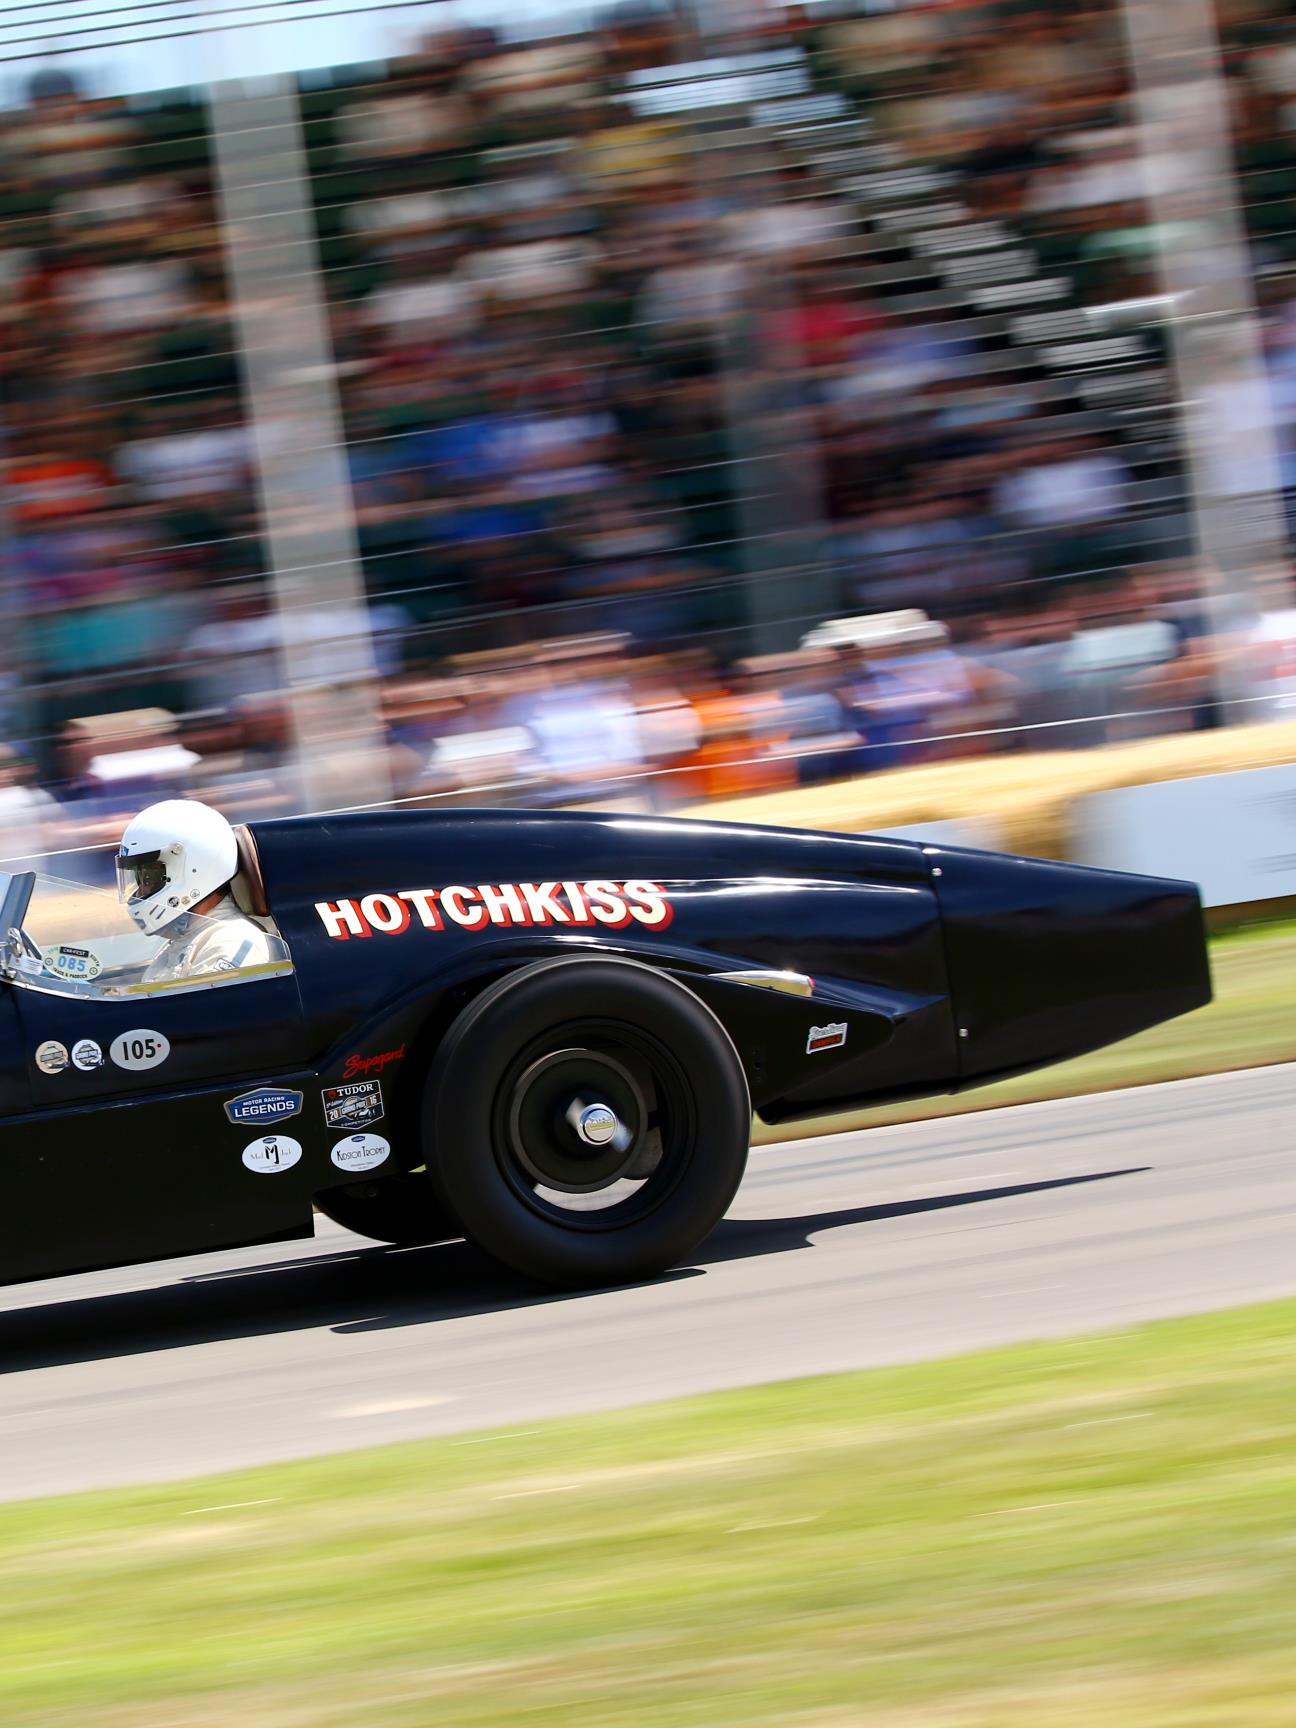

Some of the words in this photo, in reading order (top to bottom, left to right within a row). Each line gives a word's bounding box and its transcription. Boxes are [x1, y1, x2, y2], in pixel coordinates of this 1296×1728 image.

[315, 880, 673, 940] HOTCHKISS
[58, 955, 86, 972] 085
[123, 1039, 156, 1061] 105
[336, 1083, 373, 1097] TUDOR
[234, 1100, 295, 1117] LEGENDS
[329, 1109, 338, 1120] 20
